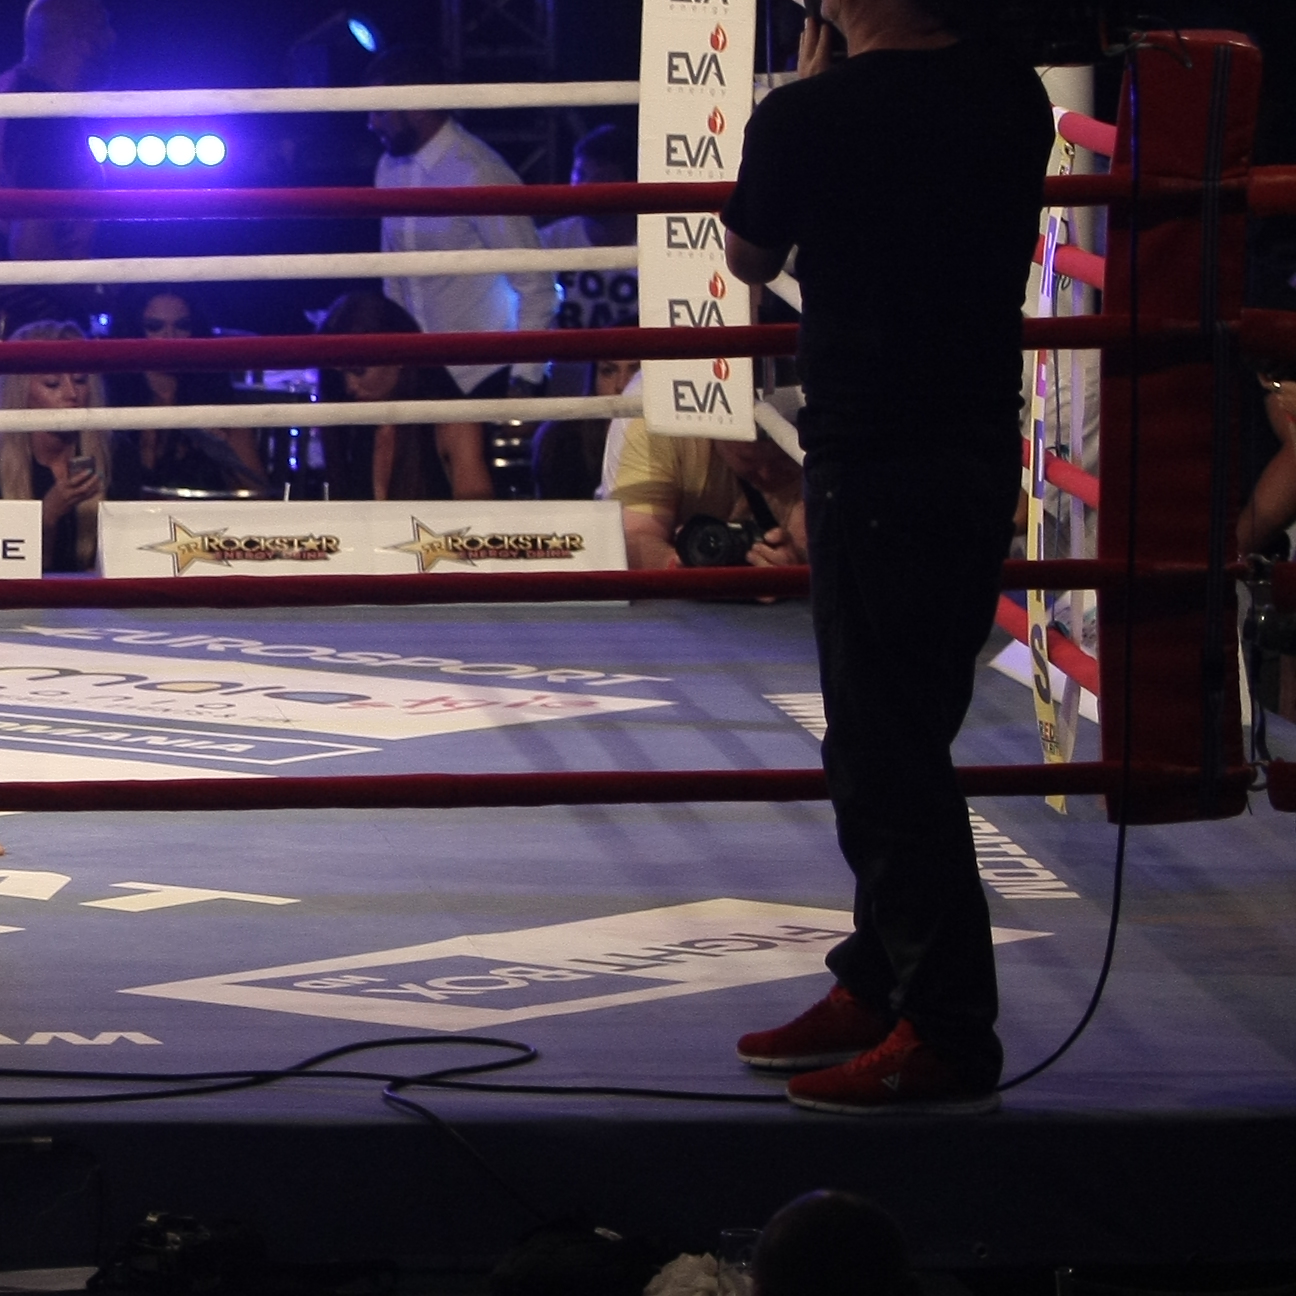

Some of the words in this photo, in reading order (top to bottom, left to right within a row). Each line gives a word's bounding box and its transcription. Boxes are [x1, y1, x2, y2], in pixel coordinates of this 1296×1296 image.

[667, 51, 726, 87] EVA
[666, 134, 724, 169] EVA
[666, 216, 724, 250] EVA
[668, 299, 726, 327] EVA
[673, 380, 733, 415] EVA
[30, 625, 673, 686] EUROSPORT
[362, 966, 597, 1001] BOX
